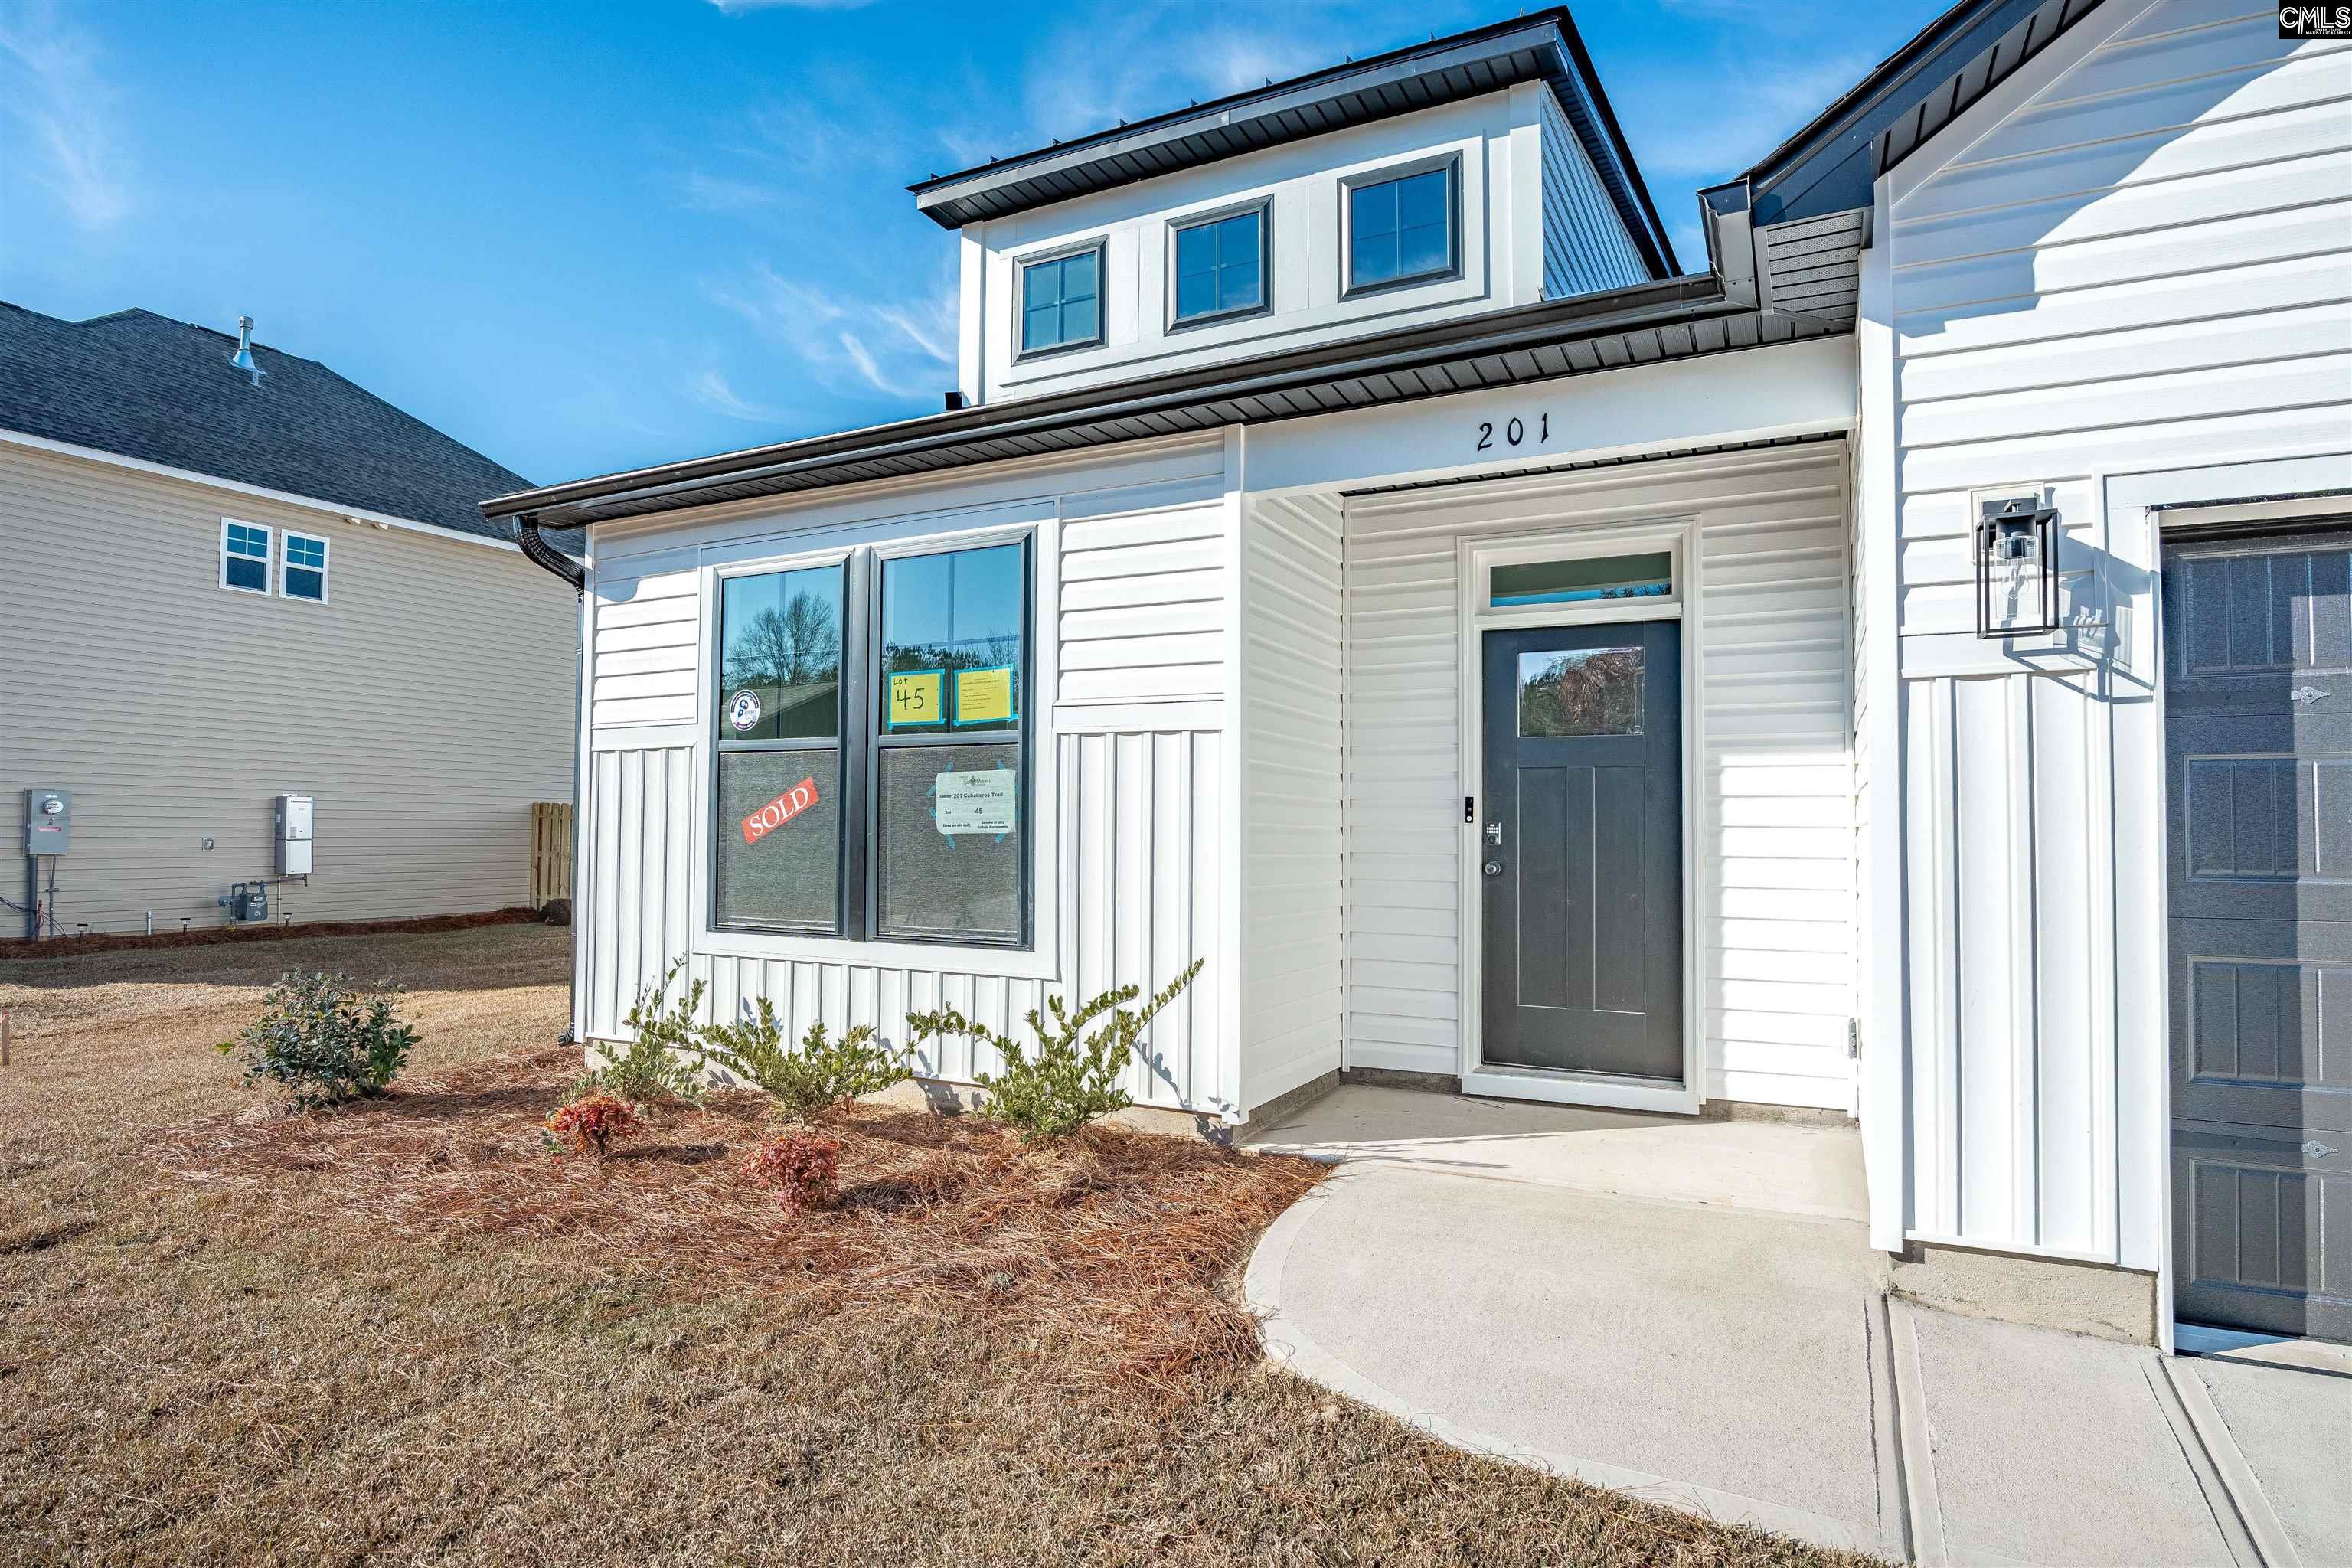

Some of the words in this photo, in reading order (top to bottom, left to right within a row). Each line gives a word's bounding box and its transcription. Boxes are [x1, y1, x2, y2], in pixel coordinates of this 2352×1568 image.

[1477, 413, 1549, 452] 201
[897, 687, 925, 710] 45
[749, 787, 809, 837] SOLD
